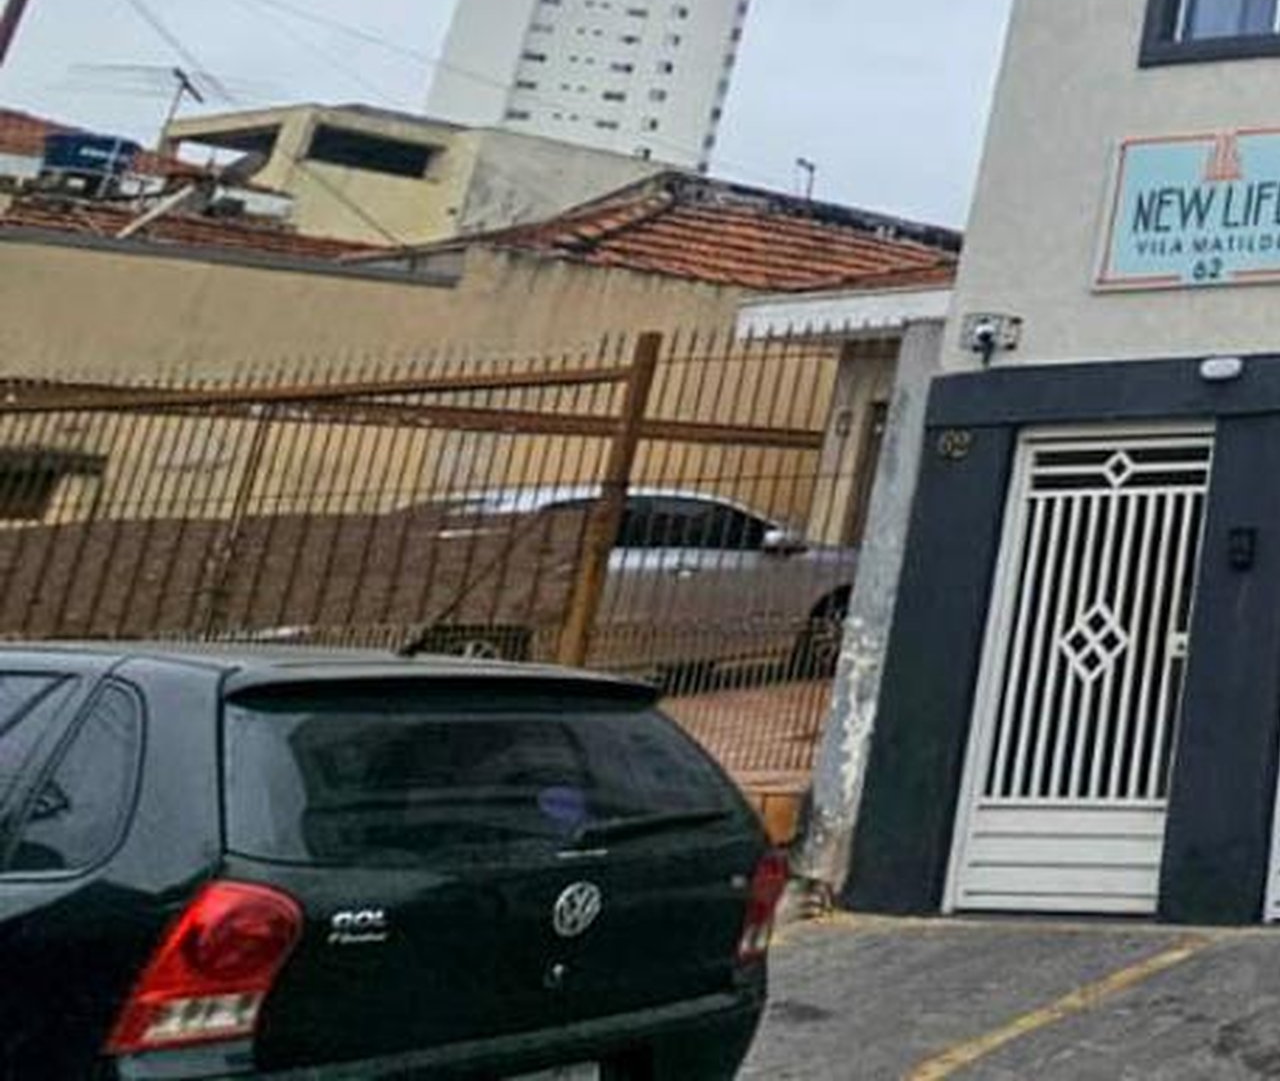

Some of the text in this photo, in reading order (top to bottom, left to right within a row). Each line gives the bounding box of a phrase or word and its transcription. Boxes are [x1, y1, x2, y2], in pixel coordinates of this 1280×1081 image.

[1132, 186, 1215, 232] NEW
[1136, 237, 1183, 256] VILA
[1192, 257, 1223, 280] 62
